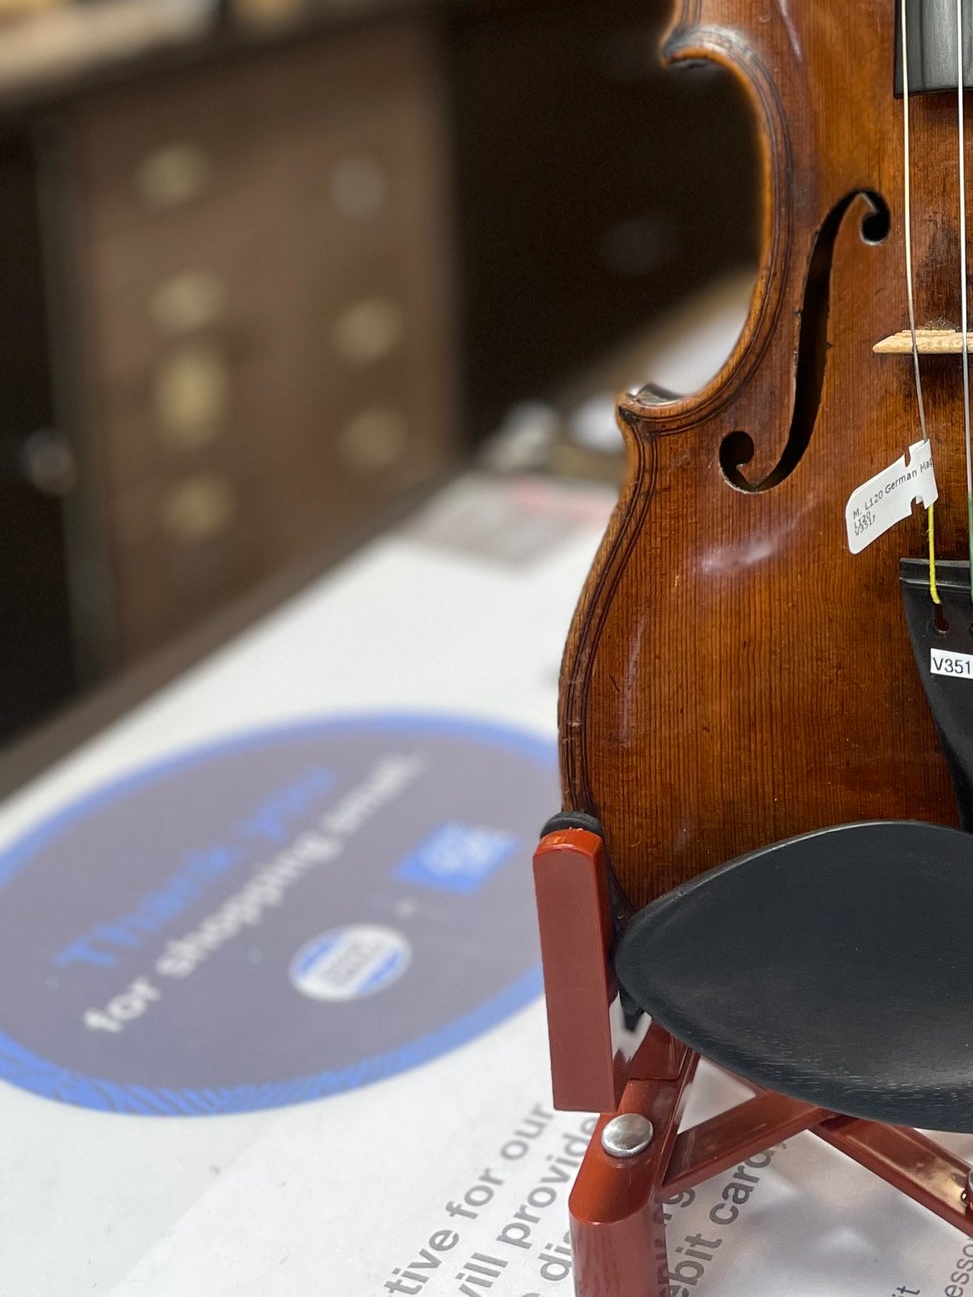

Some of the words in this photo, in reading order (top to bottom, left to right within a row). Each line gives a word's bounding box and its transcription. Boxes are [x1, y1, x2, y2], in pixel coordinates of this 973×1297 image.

[865, 490, 884, 510] L120
[884, 469, 918, 495] German
[82, 976, 159, 1033] for
[445, 1167, 505, 1220] for
[500, 1102, 554, 1161] our
[537, 1230, 573, 1282] di
